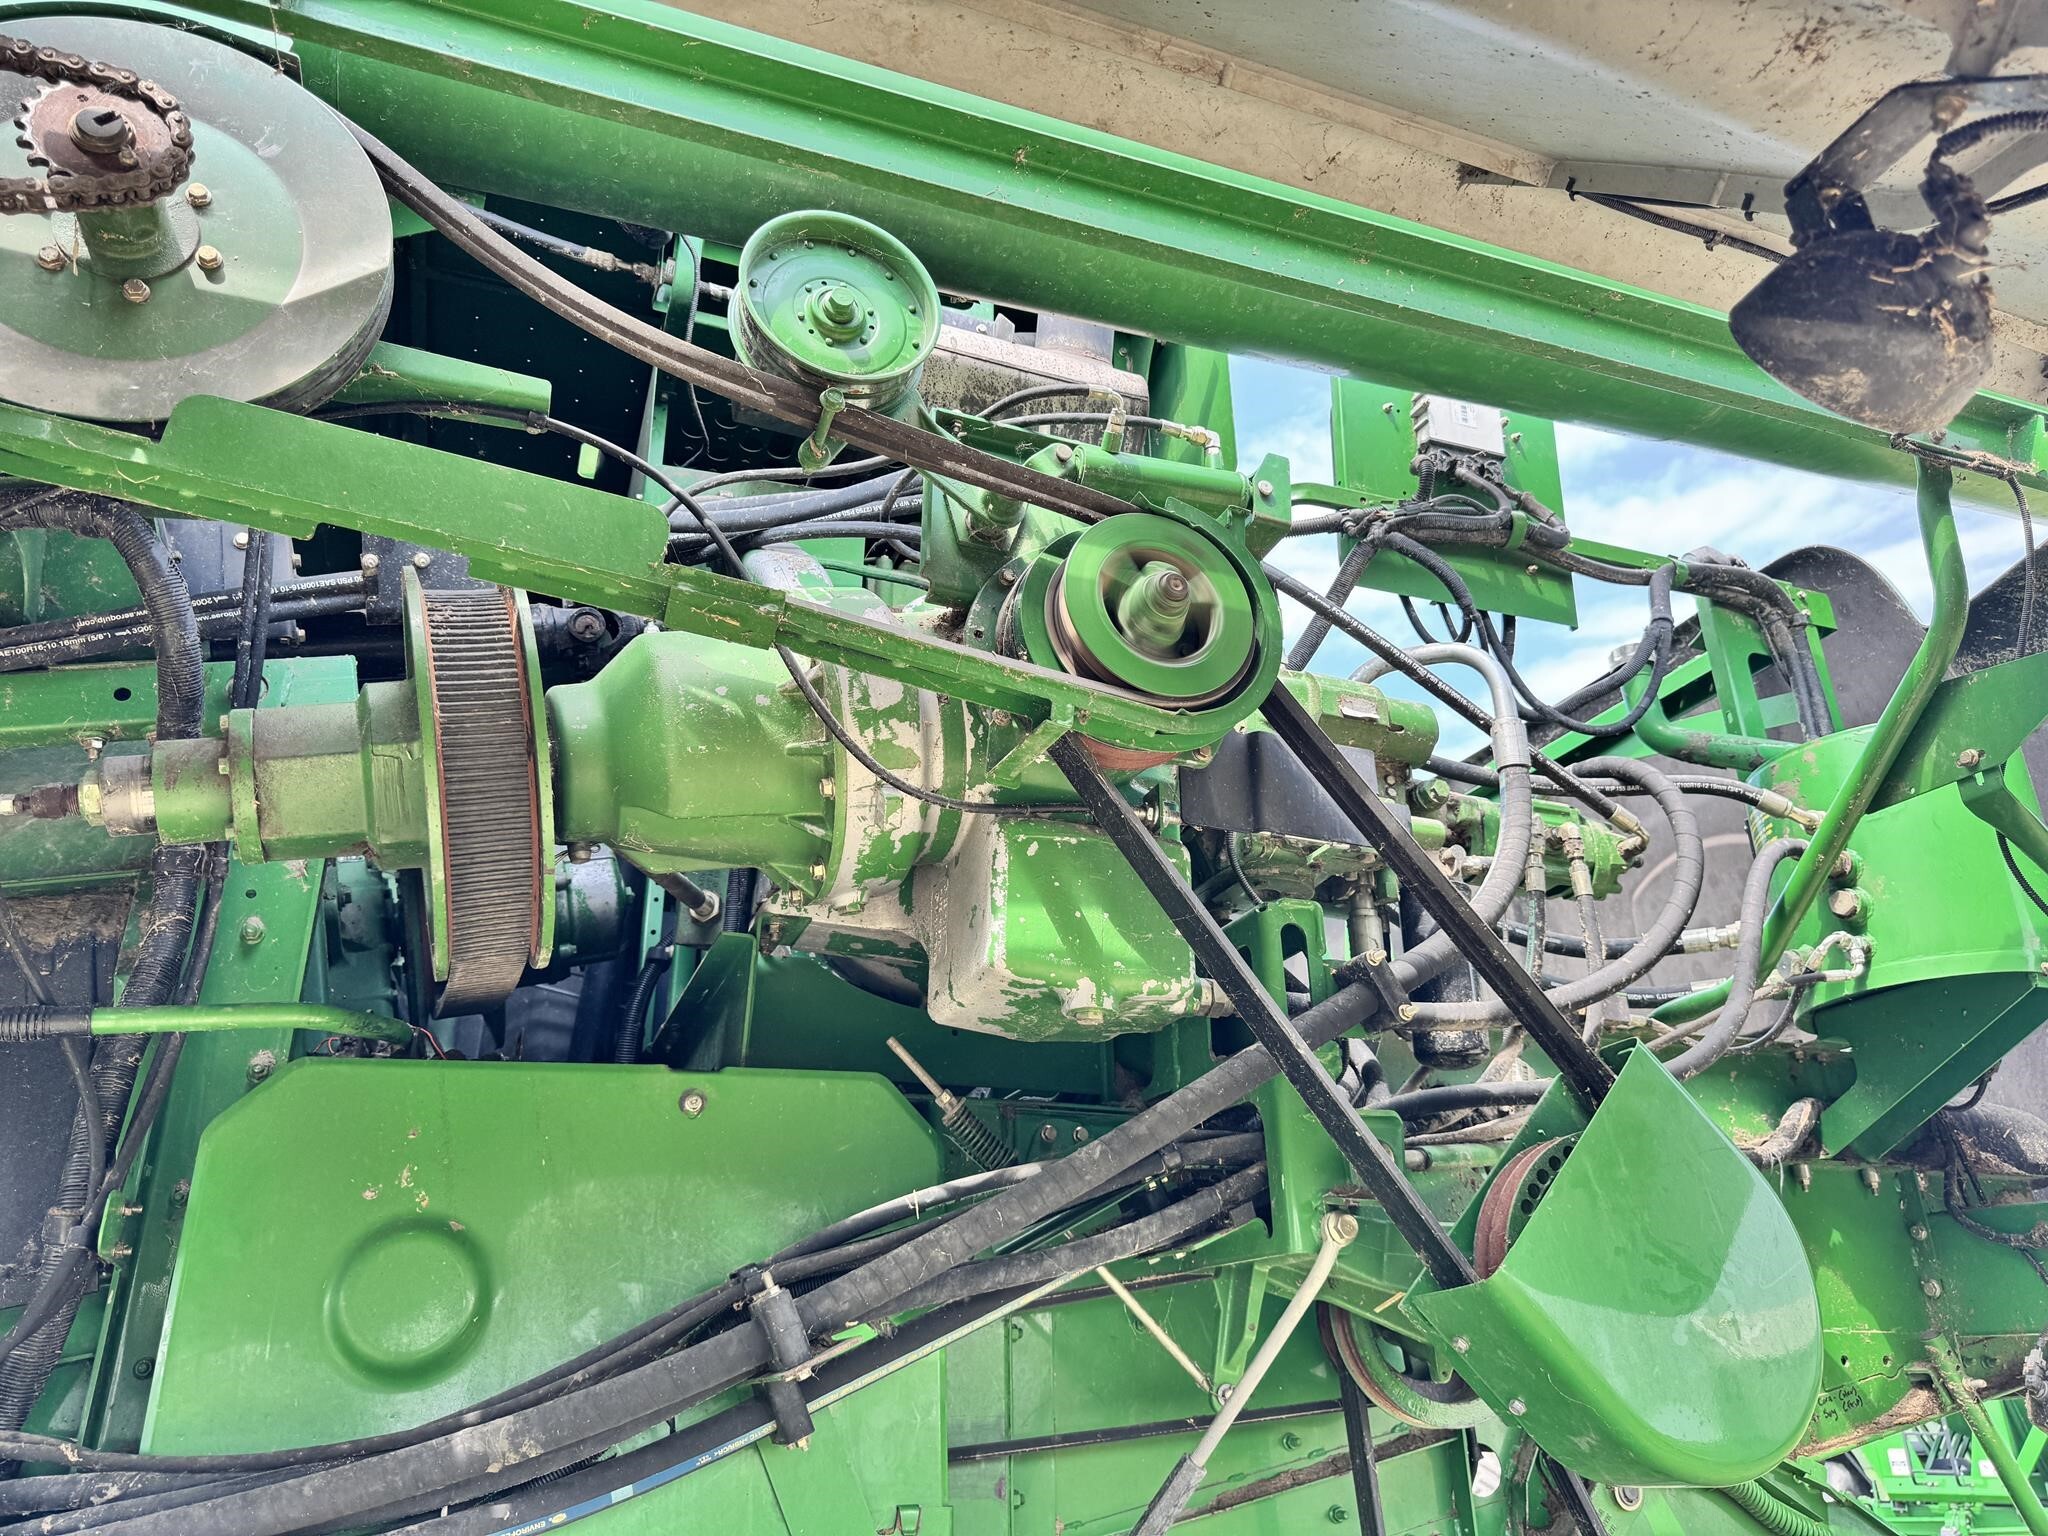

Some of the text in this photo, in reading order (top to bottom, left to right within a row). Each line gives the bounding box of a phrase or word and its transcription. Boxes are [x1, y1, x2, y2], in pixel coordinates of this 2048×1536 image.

[279, 577, 336, 593] SAE100R16-10
[76, 608, 148, 628] ww.aeroquip.com
[0, 641, 57, 658] AE100R16-10
